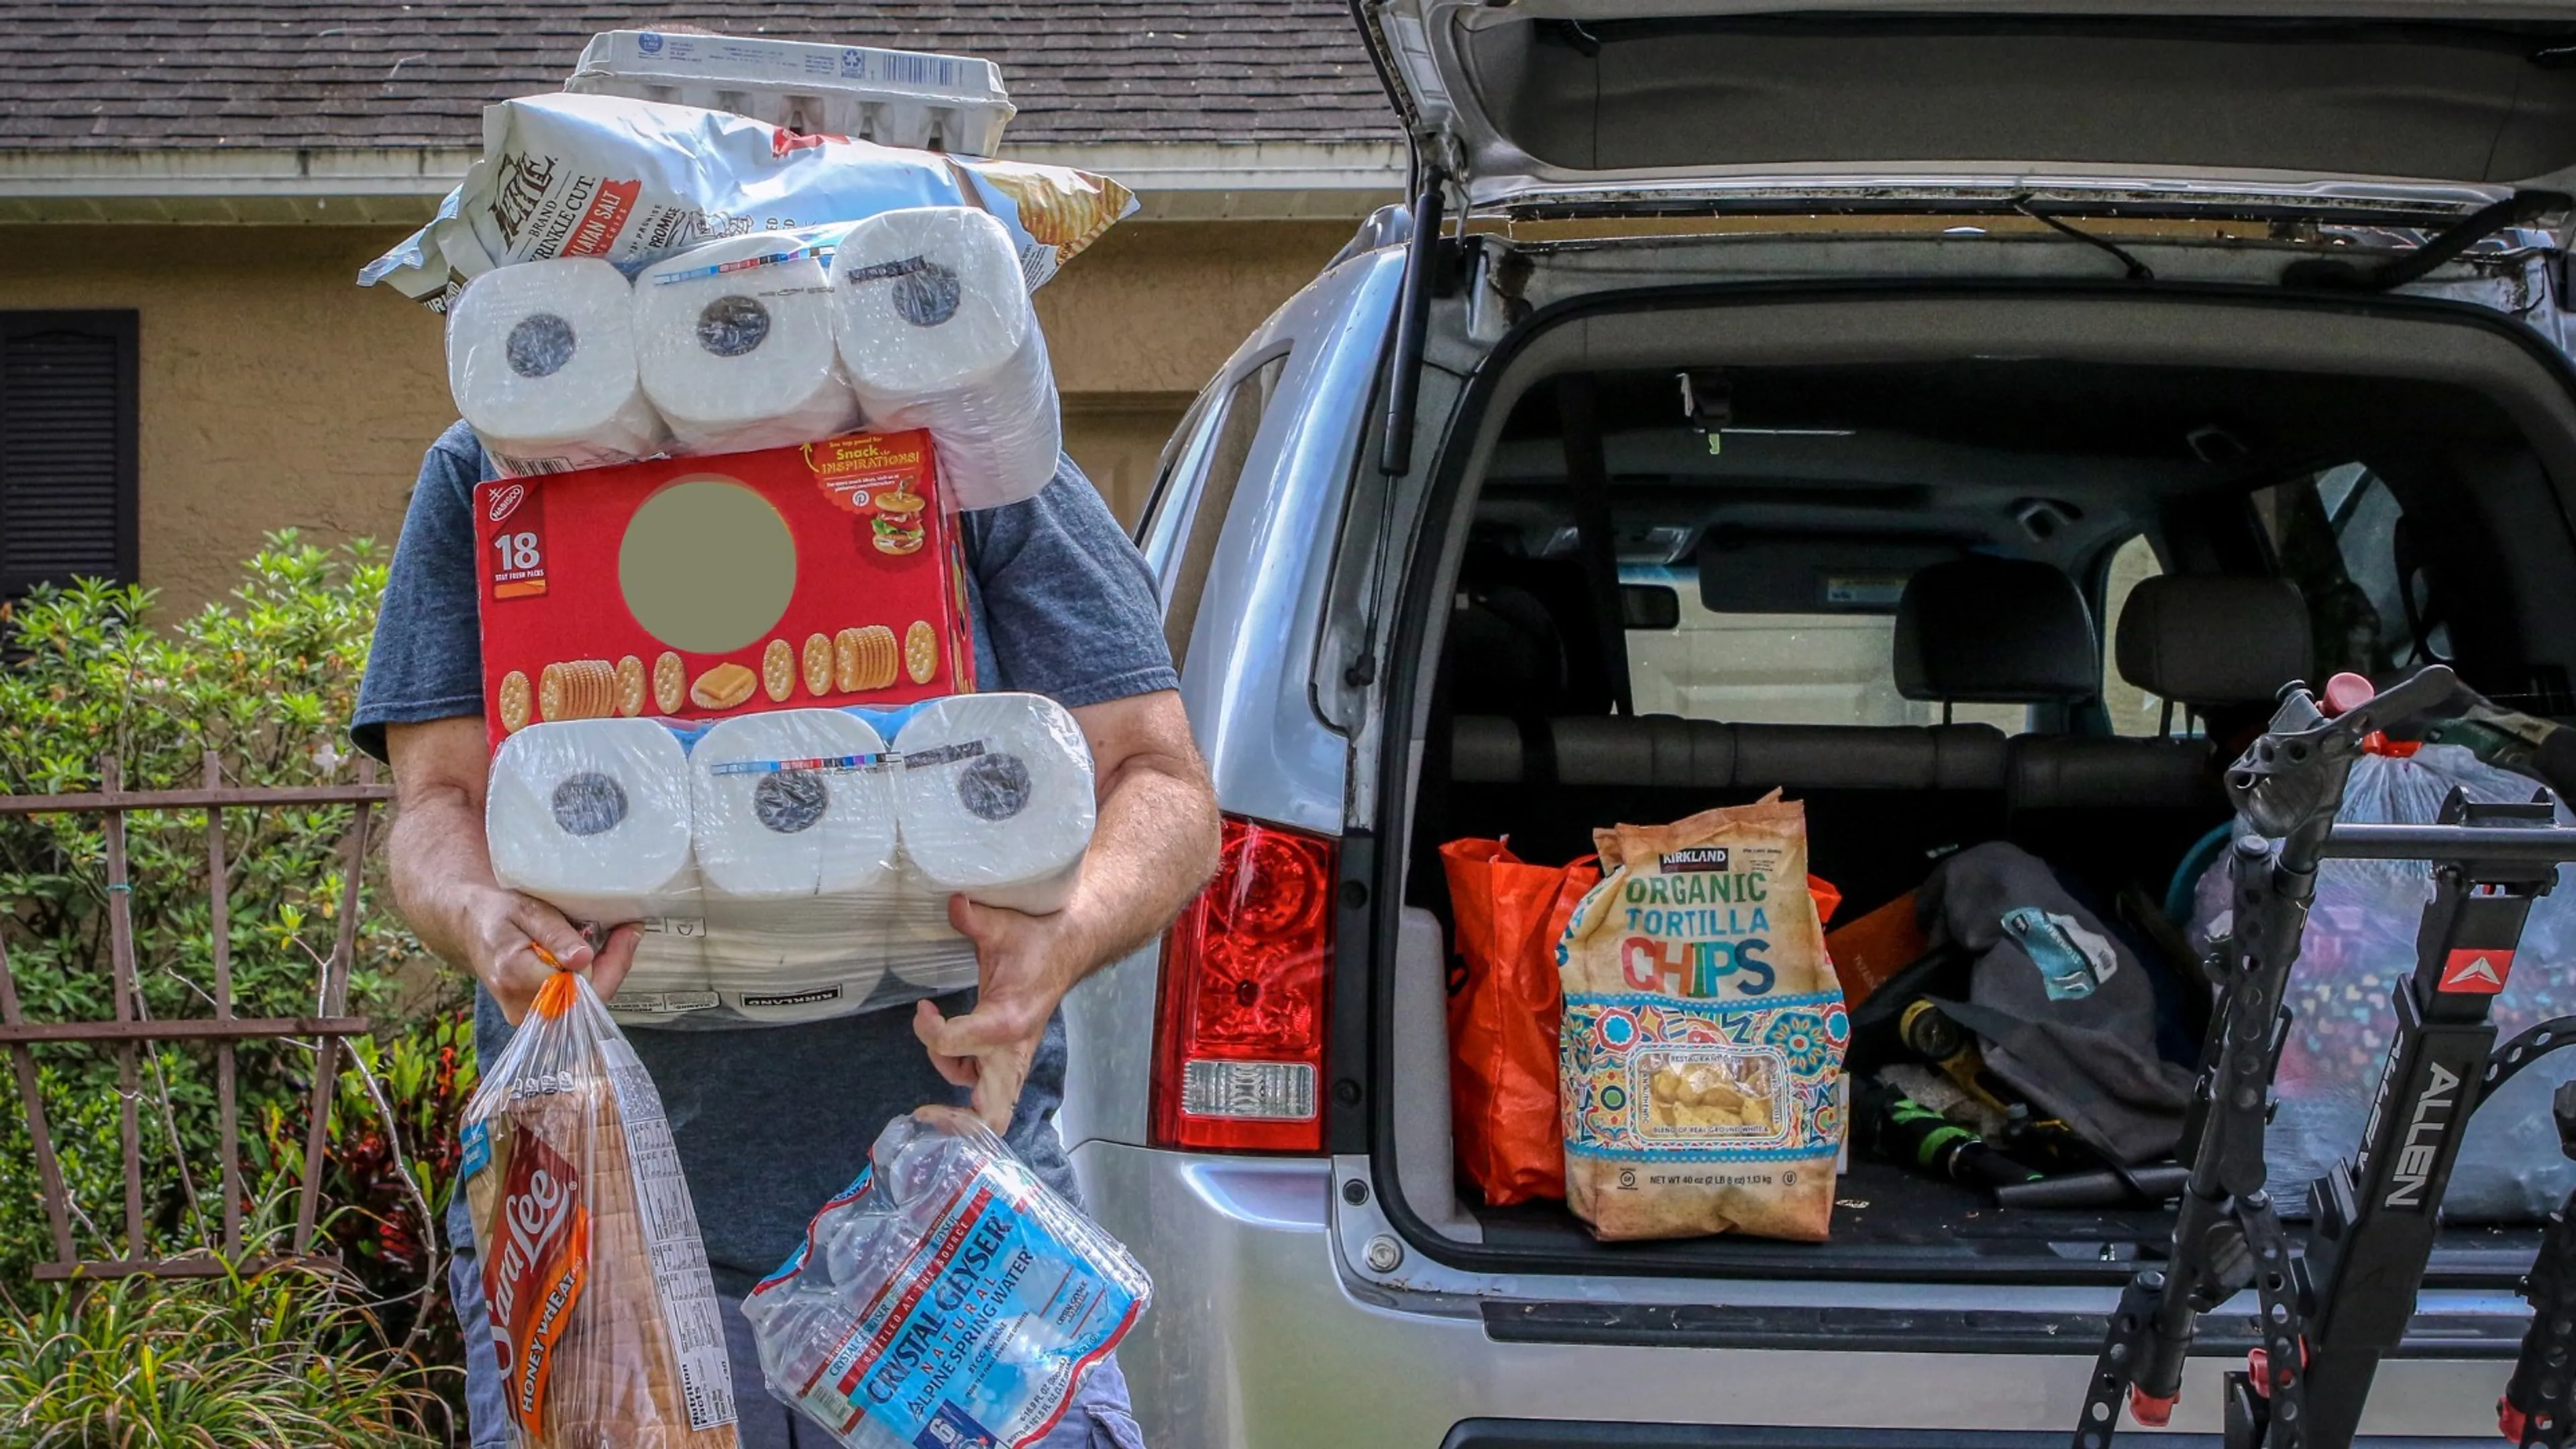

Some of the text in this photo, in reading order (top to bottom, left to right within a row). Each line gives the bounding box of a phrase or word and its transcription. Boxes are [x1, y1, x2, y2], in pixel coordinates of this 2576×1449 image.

[528, 198, 558, 239] BRAND
[592, 189, 623, 221] SALT
[646, 203, 682, 250] PROMISE
[822, 451, 920, 474] INSPIRATIONS!
[837, 445, 879, 460] Snack
[492, 487, 521, 519] NABISCO
[494, 532, 540, 570] 18
[495, 569, 544, 581] STAY FRESH PACKS
[1663, 850, 1727, 864] KIRKLAND
[1625, 872, 1768, 905] ORGANIC
[1625, 908, 1770, 936] TORTILLA
[1621, 936, 1776, 998] CHIPS
[748, 992, 833, 1006] KIRKLAND
[2385, 1061, 2460, 1208] ALLEN
[1650, 1176, 1664, 1184] NET
[1668, 1176, 1679, 1184] WT
[1682, 1176, 1693, 1184] 40
[1705, 1176, 1713, 1185] (2
[1715, 1176, 1725, 1184] LB
[1747, 1175, 1762, 1183] 1.13
[1762, 1175, 1772, 1185] kg
[486, 1169, 569, 1381] Sara Lee
[863, 1220, 970, 1365] BOTTLED AT THE SOURCE
[865, 1214, 1013, 1405] CRYSTAL GEYSER
[919, 1271, 997, 1378] NATURAL
[523, 1336, 546, 1413] HONEY
[537, 1271, 576, 1335] WHEAT
[903, 1355, 958, 1424] ALPINE
[948, 1300, 999, 1366] SPRING
[989, 1248, 1034, 1307] WATER
[967, 1321, 1008, 1374] BY CG ROXANE
[827, 1340, 859, 1379] CRYSTAL
[682, 1364, 700, 1426] Nutrition
[695, 1386, 708, 1424] Facts
[930, 1417, 956, 1443] 6
